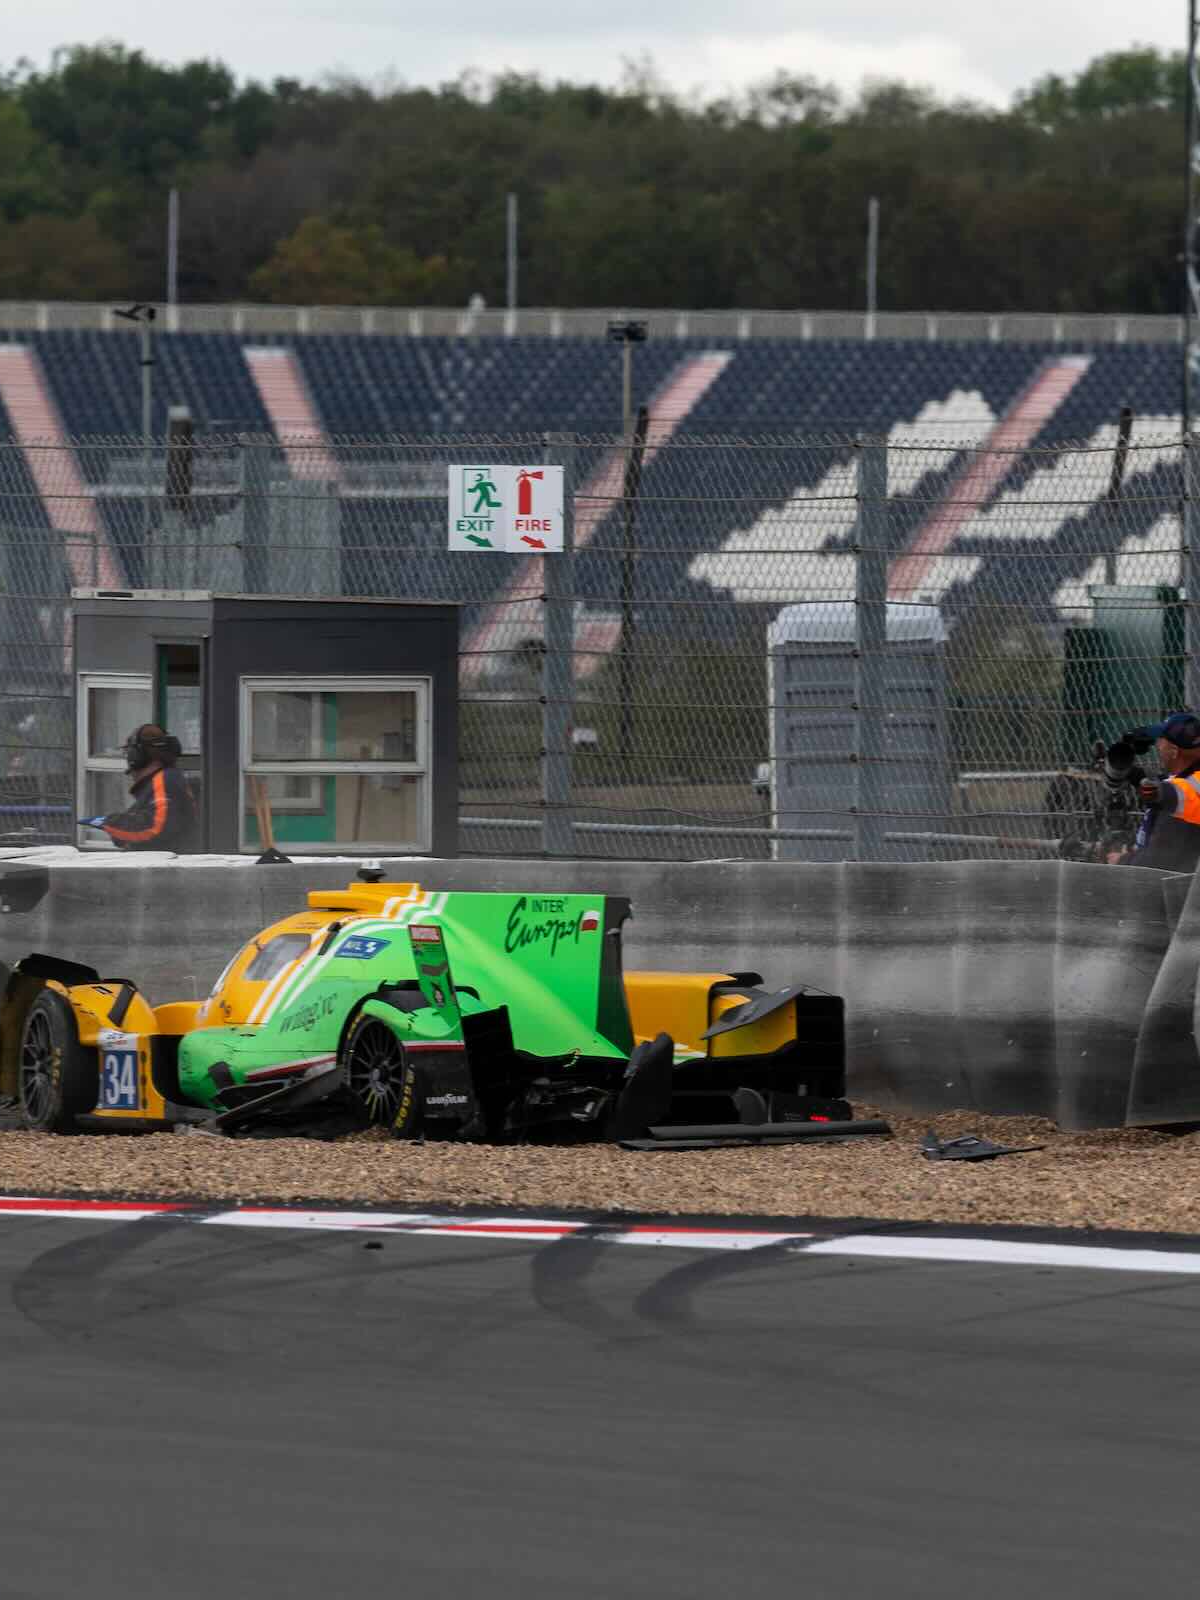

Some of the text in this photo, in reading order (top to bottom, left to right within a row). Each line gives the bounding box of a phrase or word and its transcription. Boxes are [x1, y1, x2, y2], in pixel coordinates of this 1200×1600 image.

[456, 520, 495, 531] EXIT
[515, 519, 552, 531] FIRE
[532, 899, 564, 912] INTER
[504, 897, 584, 957] Europol
[104, 1054, 136, 1105] 34
